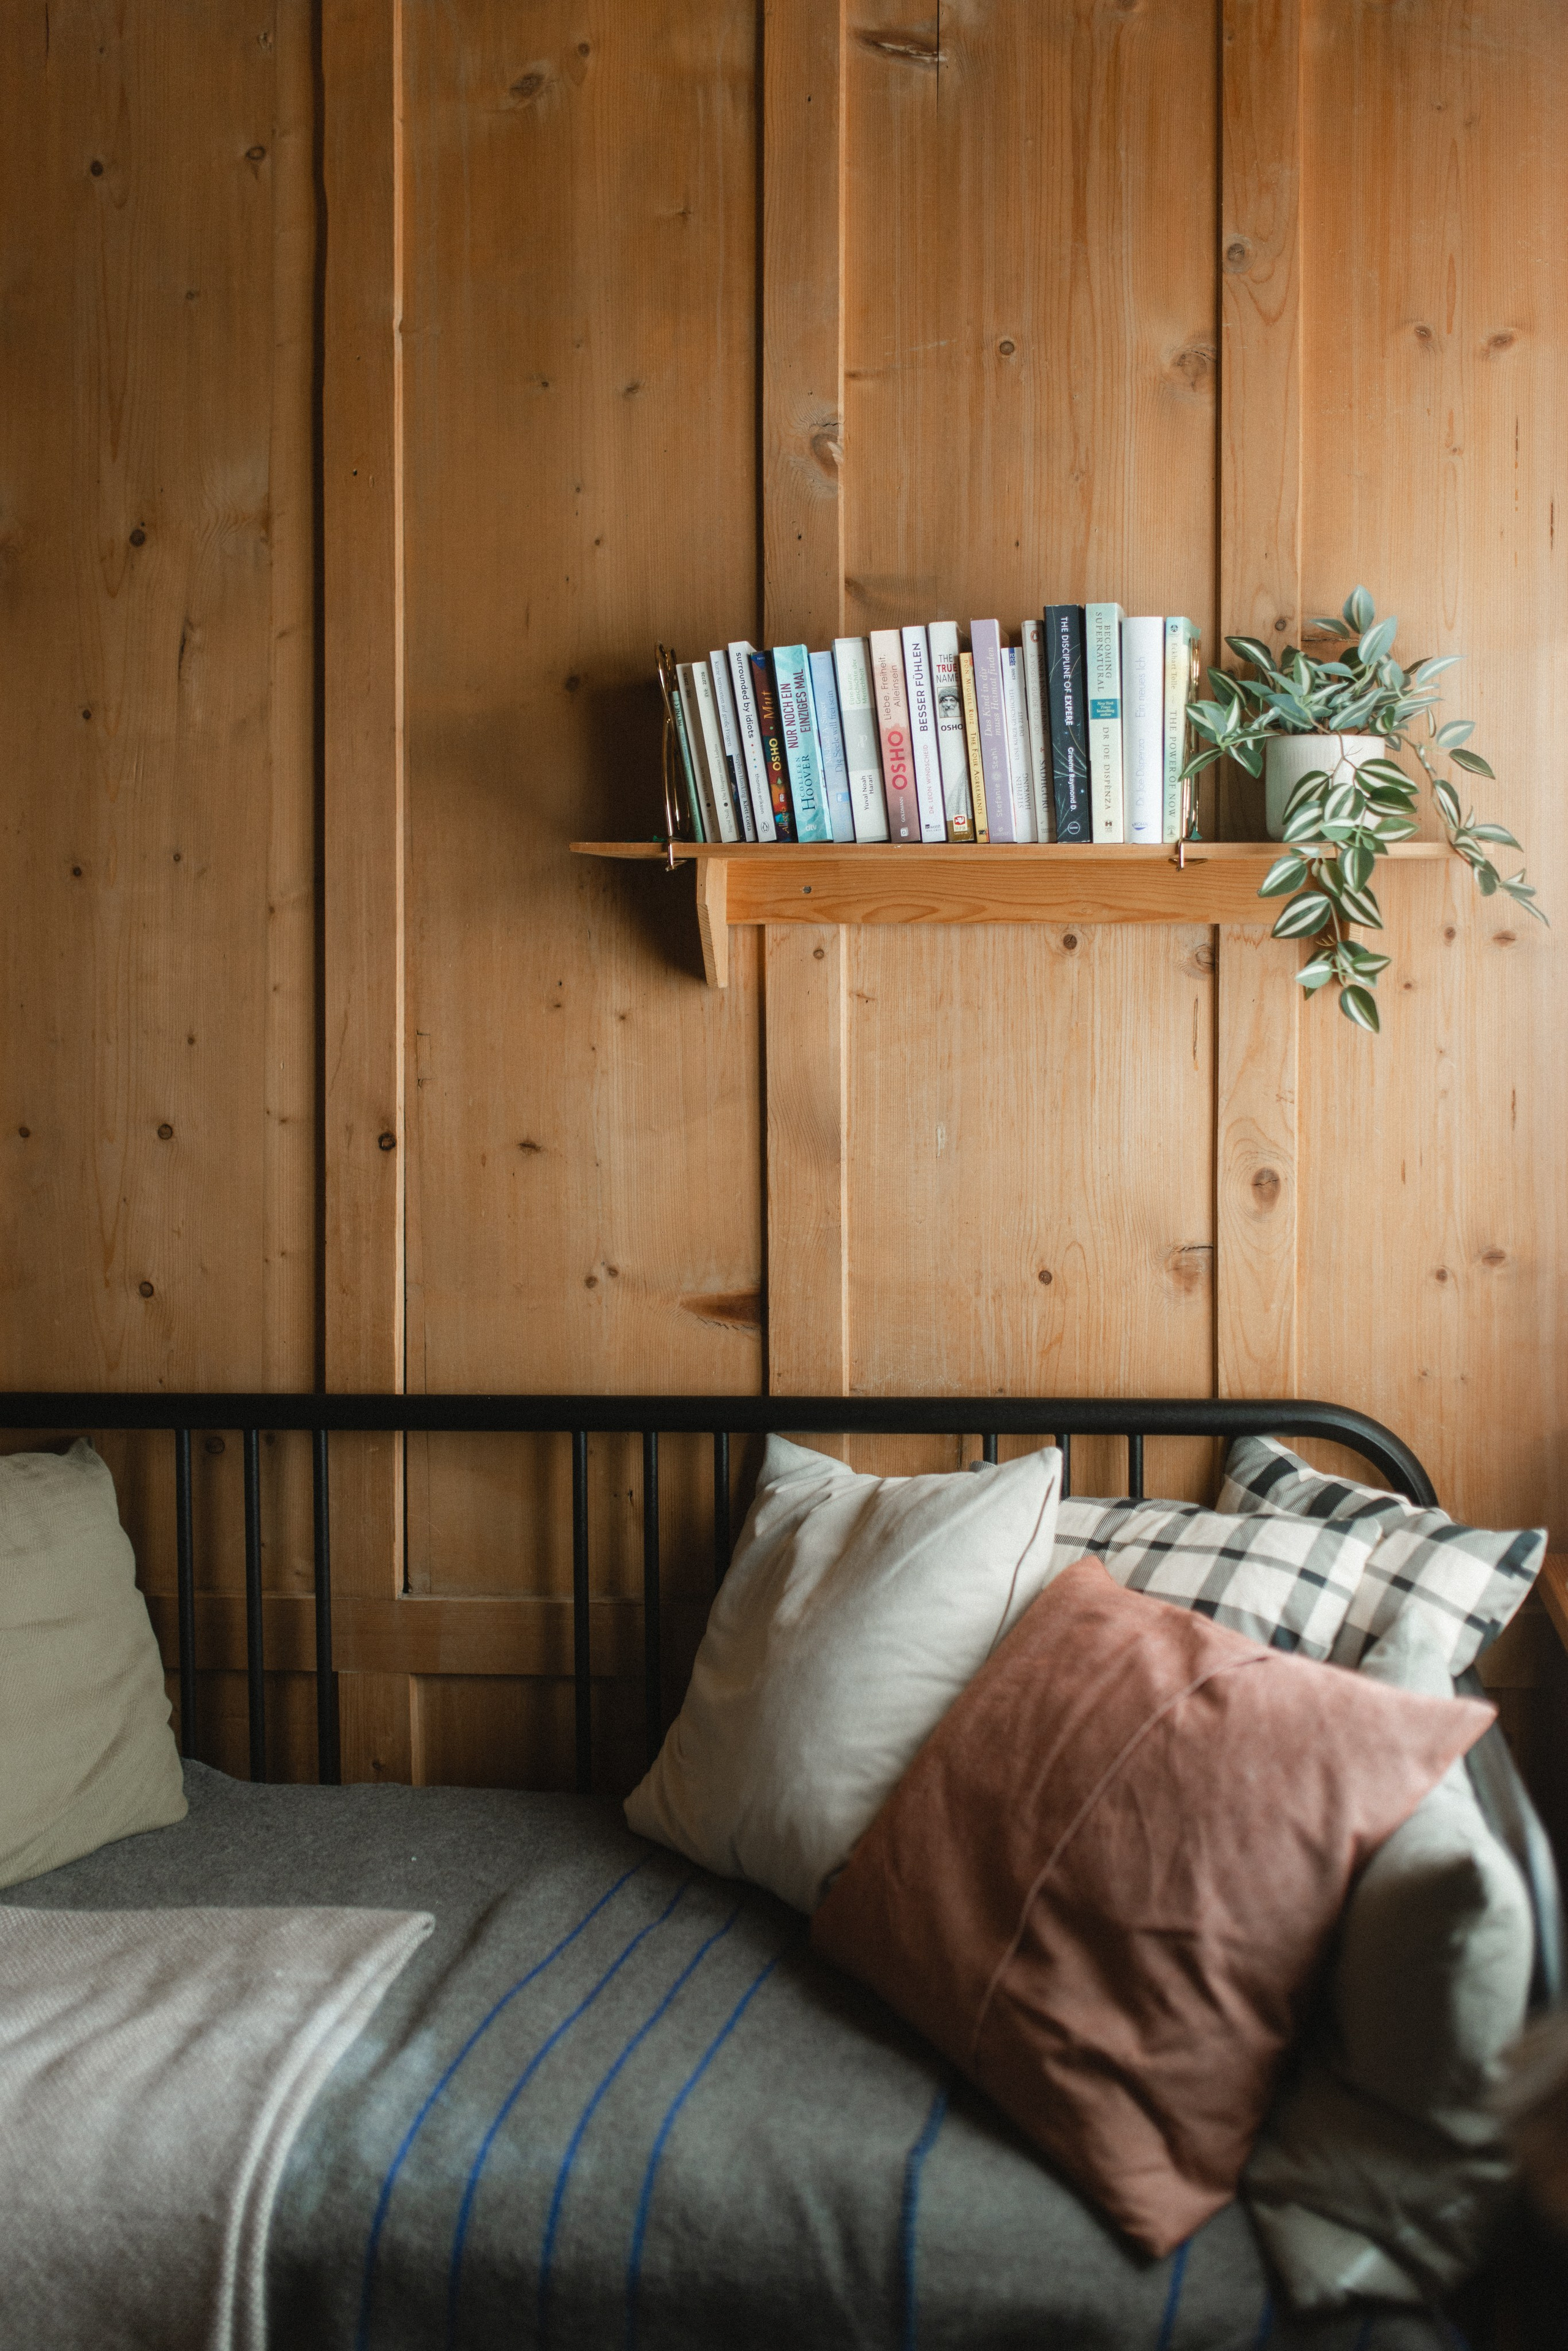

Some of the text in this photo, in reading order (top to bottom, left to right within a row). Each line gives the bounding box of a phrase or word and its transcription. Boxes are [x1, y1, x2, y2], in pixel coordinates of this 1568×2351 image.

[936, 663, 958, 673] TRUE
[938, 654, 953, 663] THE
[987, 647, 998, 676] finden
[1061, 635, 1071, 679] DISCIPLINE
[1095, 612, 1105, 693] SUPERNATURAL
[1134, 657, 1146, 670] Ich
[736, 652, 750, 700] surrounded
[743, 702, 750, 712] by
[859, 668, 868, 704] Menschheit
[878, 654, 892, 721] Liebe, Freiheit,
[891, 665, 902, 708] Alleinsein
[912, 643, 929, 732] BESSER FÜHLEN
[936, 673, 959, 683] NAME
[979, 666, 988, 681] dir
[981, 682, 989, 692] in
[1064, 681, 1071, 693] OF
[717, 676, 725, 704] Antworten
[761, 690, 775, 719] Mut
[793, 668, 811, 733] EINZIGES MAL
[990, 678, 999, 711] Heimat
[780, 683, 799, 749] NUR NOCH EIN
[982, 696, 991, 717] Kind
[1033, 711, 1039, 720] TO
[1065, 695, 1073, 726] EXPERE
[1135, 704, 1145, 718] Ein
[829, 719, 838, 735] will
[1102, 727, 1109, 740] DR
[768, 738, 782, 771] OSHO
[832, 736, 841, 758] Seele
[888, 731, 908, 790] OSHO
[1136, 739, 1146, 777] Dispenza
[795, 757, 805, 798] COLLEEN
[835, 757, 844, 772] Die
[739, 776, 747, 798] Hawking
[973, 769, 983, 815] AGREEMENTS
[990, 748, 1003, 818] Stefanie Stahl
[1016, 775, 1024, 809] STEPHEN
[1022, 773, 1031, 810] HAWKING
[1039, 760, 1049, 813] SADHGURU
[1137, 779, 1145, 793] Joe
[1169, 777, 1176, 789] OF
[742, 800, 752, 831] Klett-Cotta
